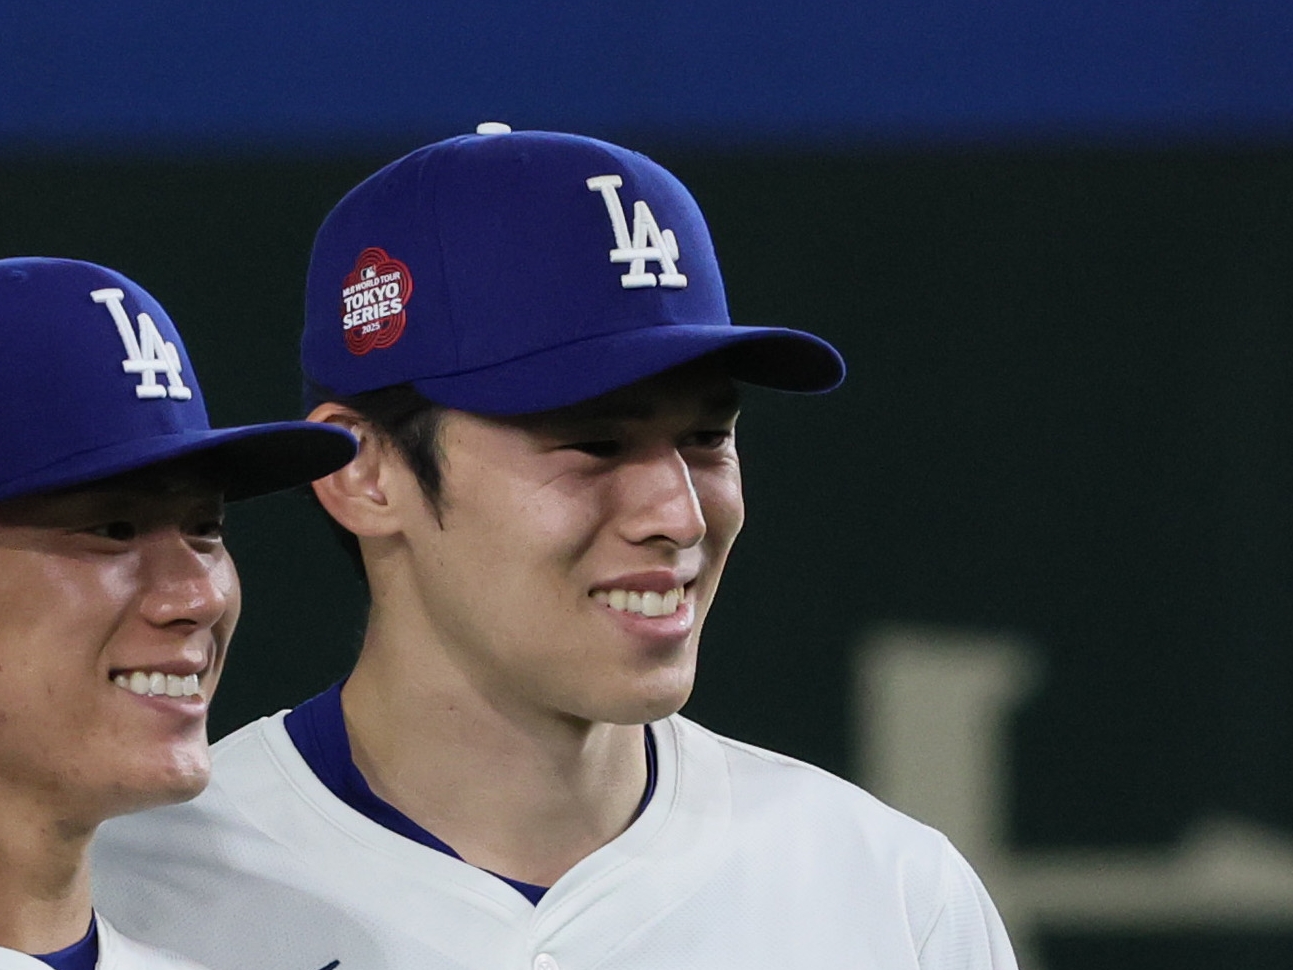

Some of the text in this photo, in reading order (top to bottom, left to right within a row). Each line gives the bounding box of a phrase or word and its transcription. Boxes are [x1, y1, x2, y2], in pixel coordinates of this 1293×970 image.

[586, 175, 687, 288] LA
[355, 278, 380, 291] WORLD
[381, 272, 401, 283] TOUR
[343, 283, 399, 312] TOKYO
[343, 298, 402, 330] SERIES
[362, 322, 381, 334] 2025
[90, 288, 192, 400] LA
